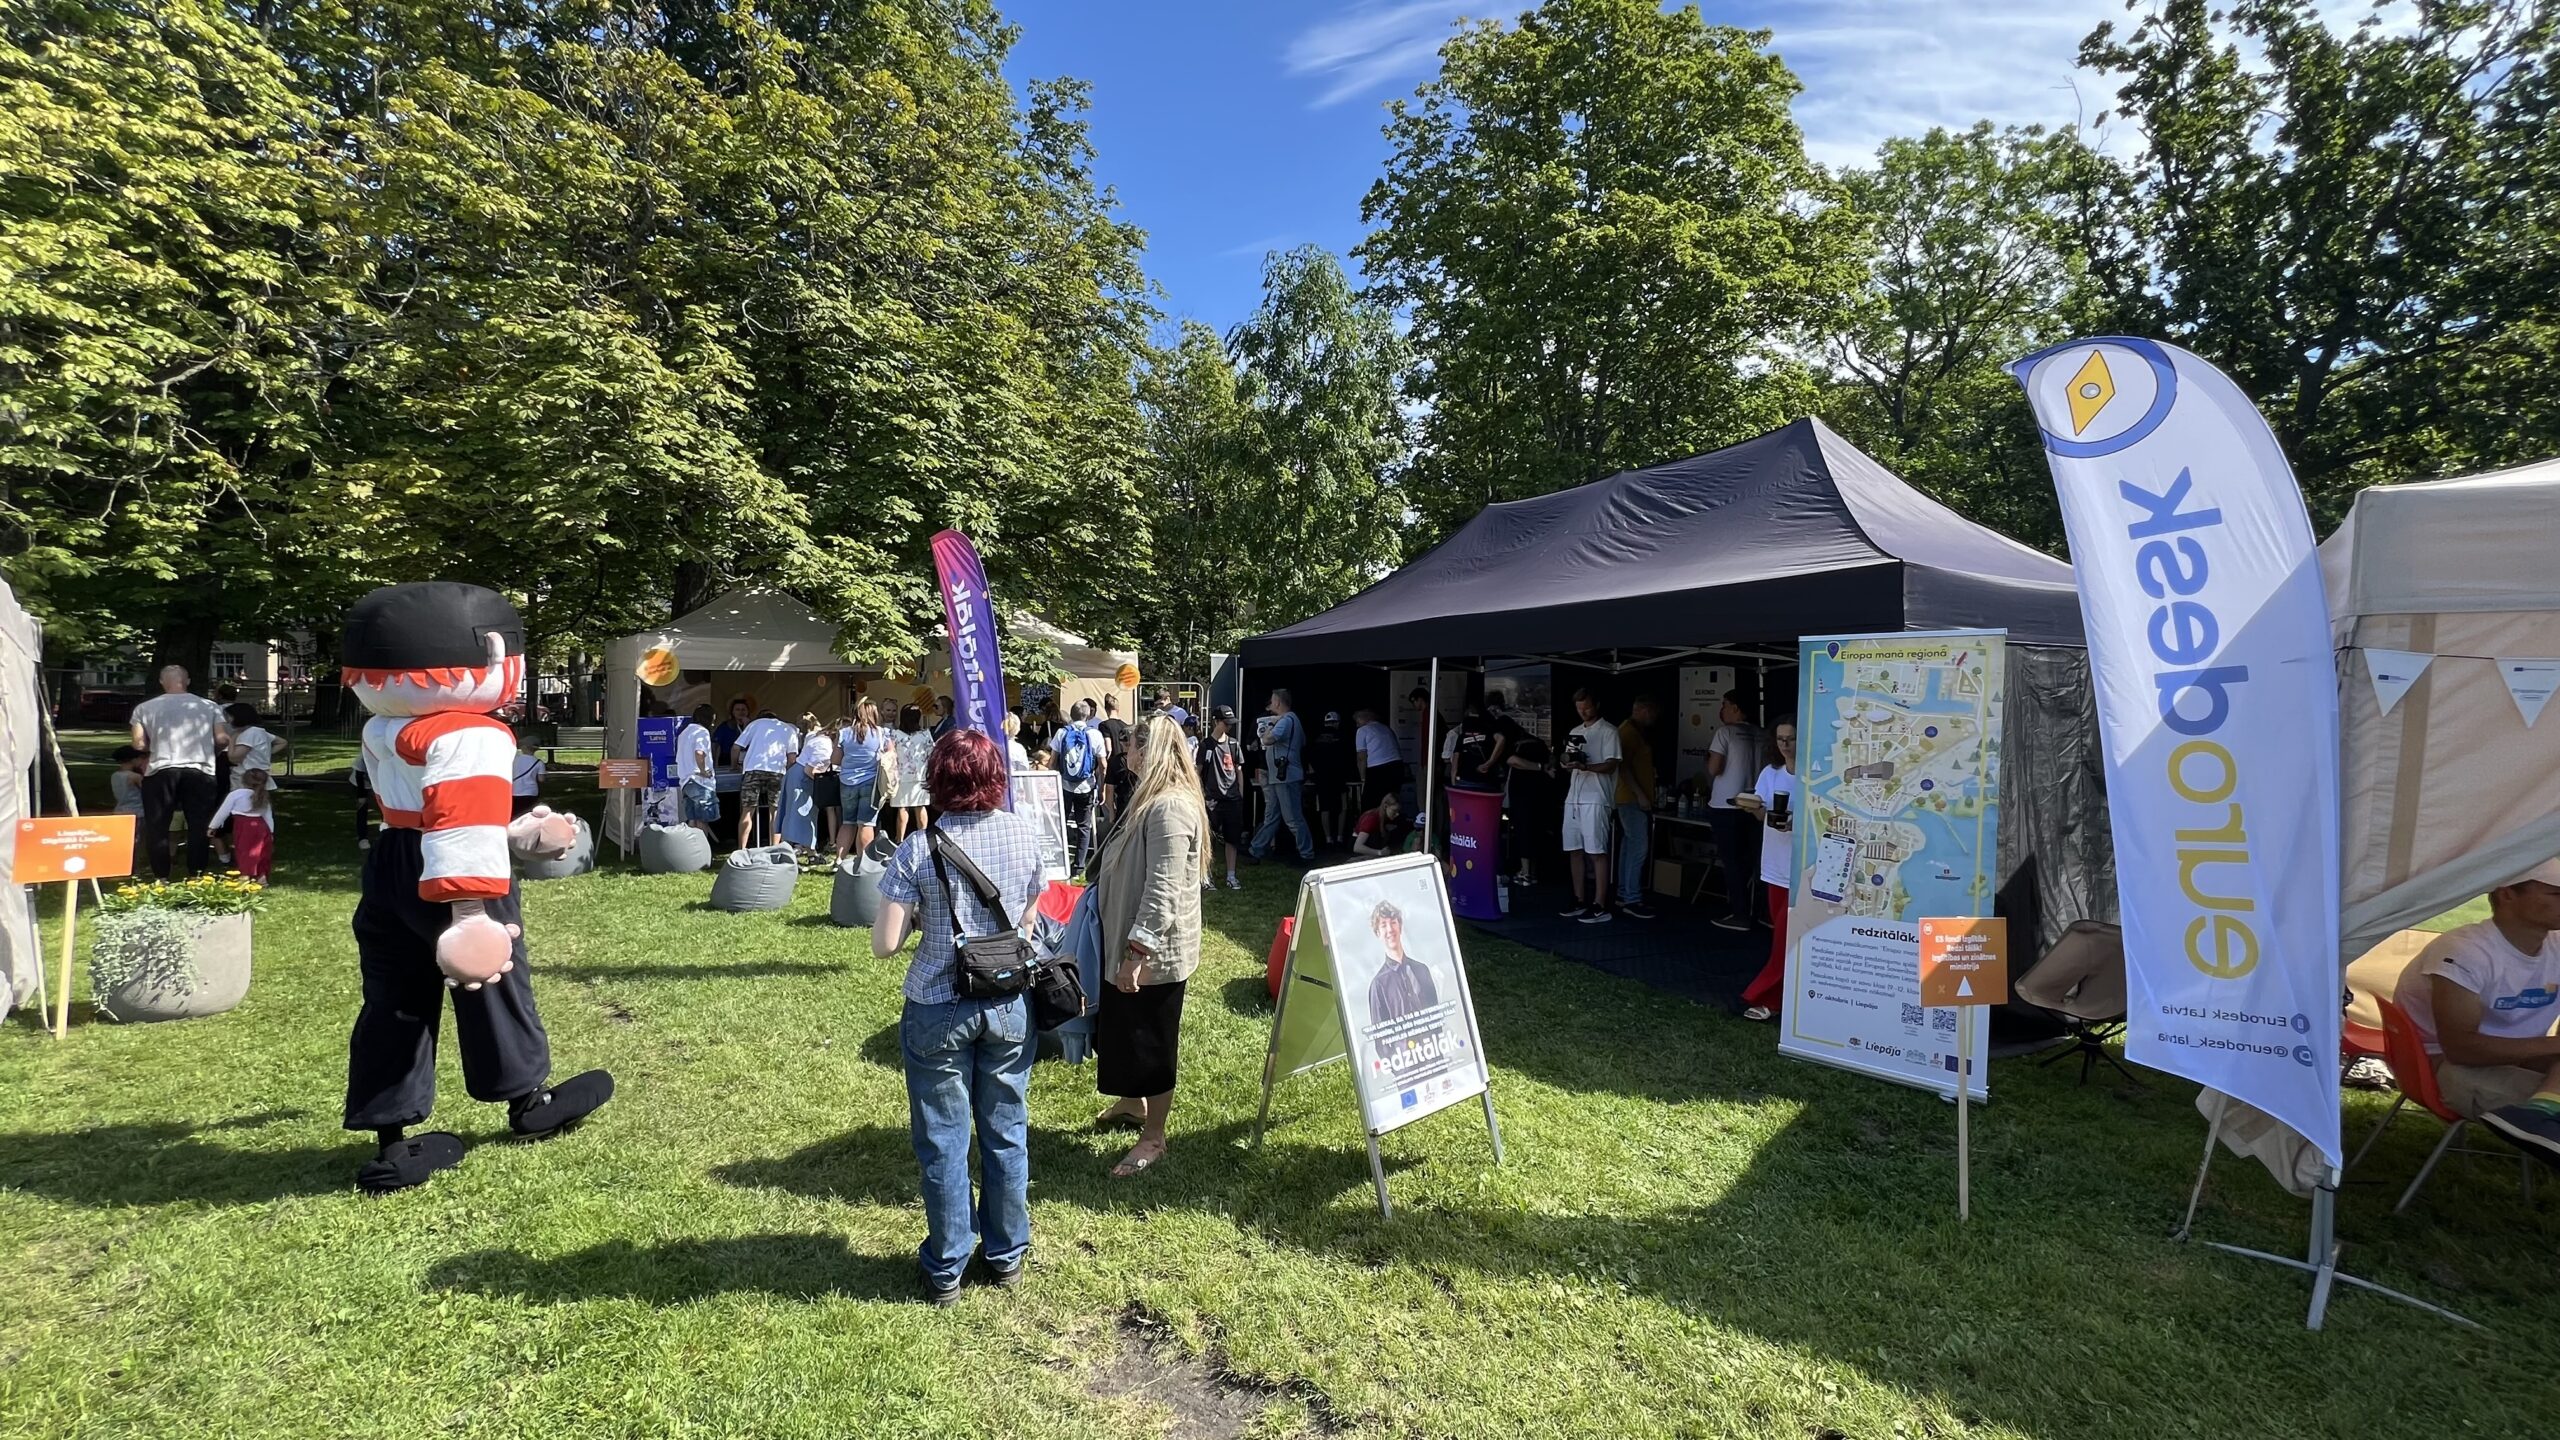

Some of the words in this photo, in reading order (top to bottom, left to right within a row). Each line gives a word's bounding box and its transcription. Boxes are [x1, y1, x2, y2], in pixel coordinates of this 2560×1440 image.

[1841, 651, 1872, 662] Eiropa
[1875, 650, 1904, 659] manā
[1907, 649, 1947, 660] reģionā
[1950, 963, 1980, 972] ministrija
[1865, 1041, 1901, 1057] Liepāja
